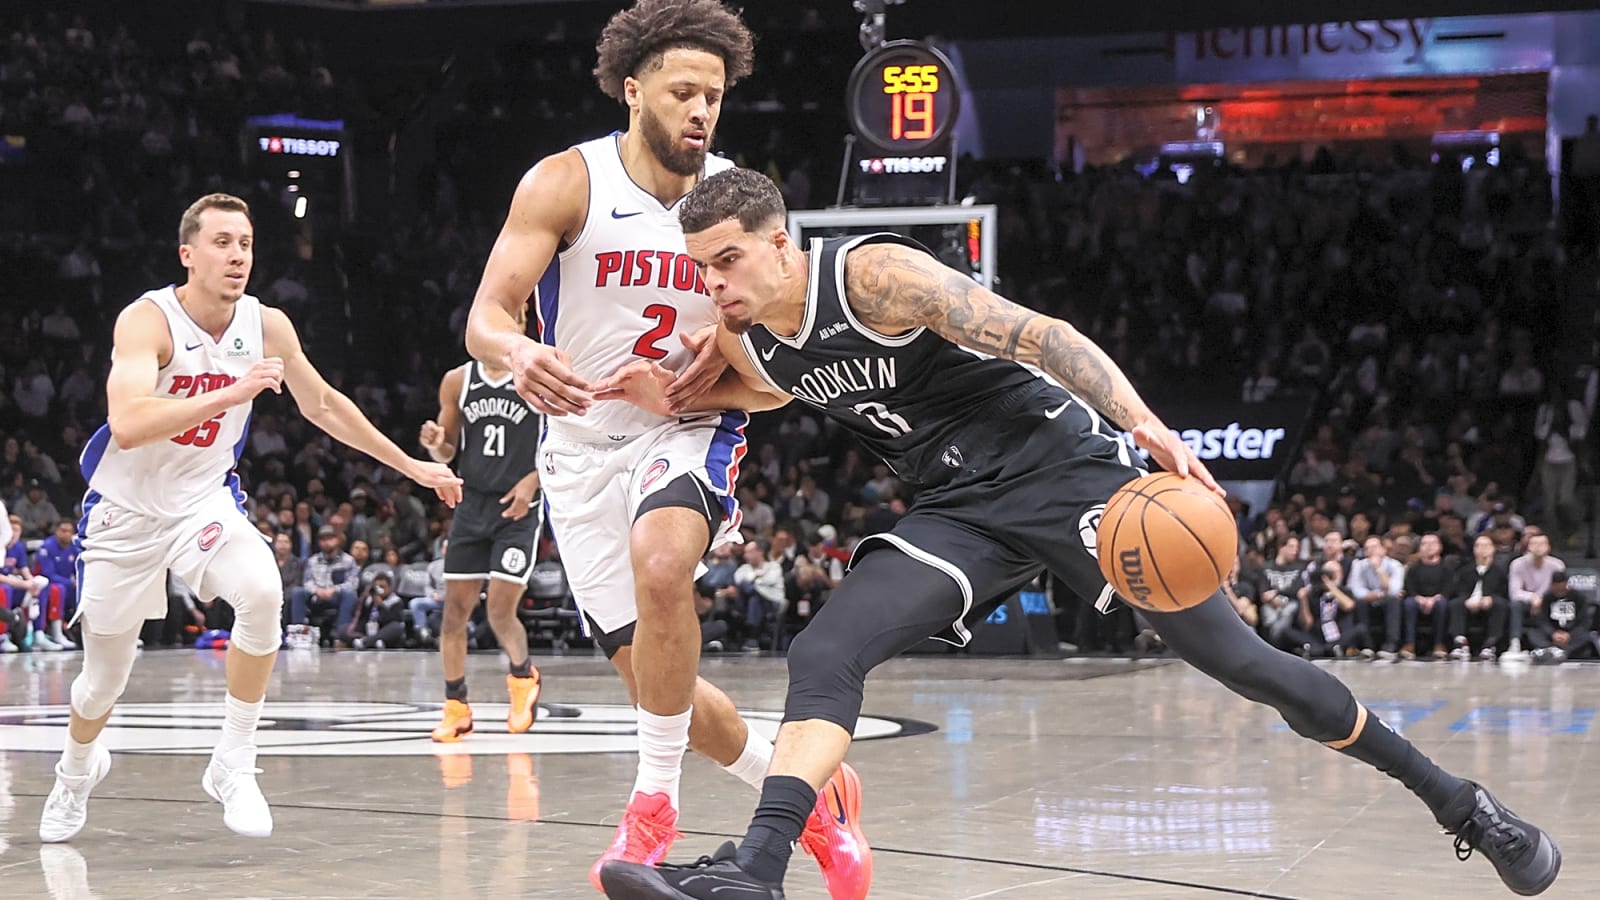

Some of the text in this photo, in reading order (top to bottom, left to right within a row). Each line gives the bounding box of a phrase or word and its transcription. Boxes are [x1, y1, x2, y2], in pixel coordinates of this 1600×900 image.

[891, 92, 934, 140] 19
[282, 138, 340, 156] TISSOT
[882, 156, 946, 173] TISSOT
[631, 303, 677, 360] 2
[463, 397, 529, 424] BROOKLYN
[483, 424, 505, 457] 21
